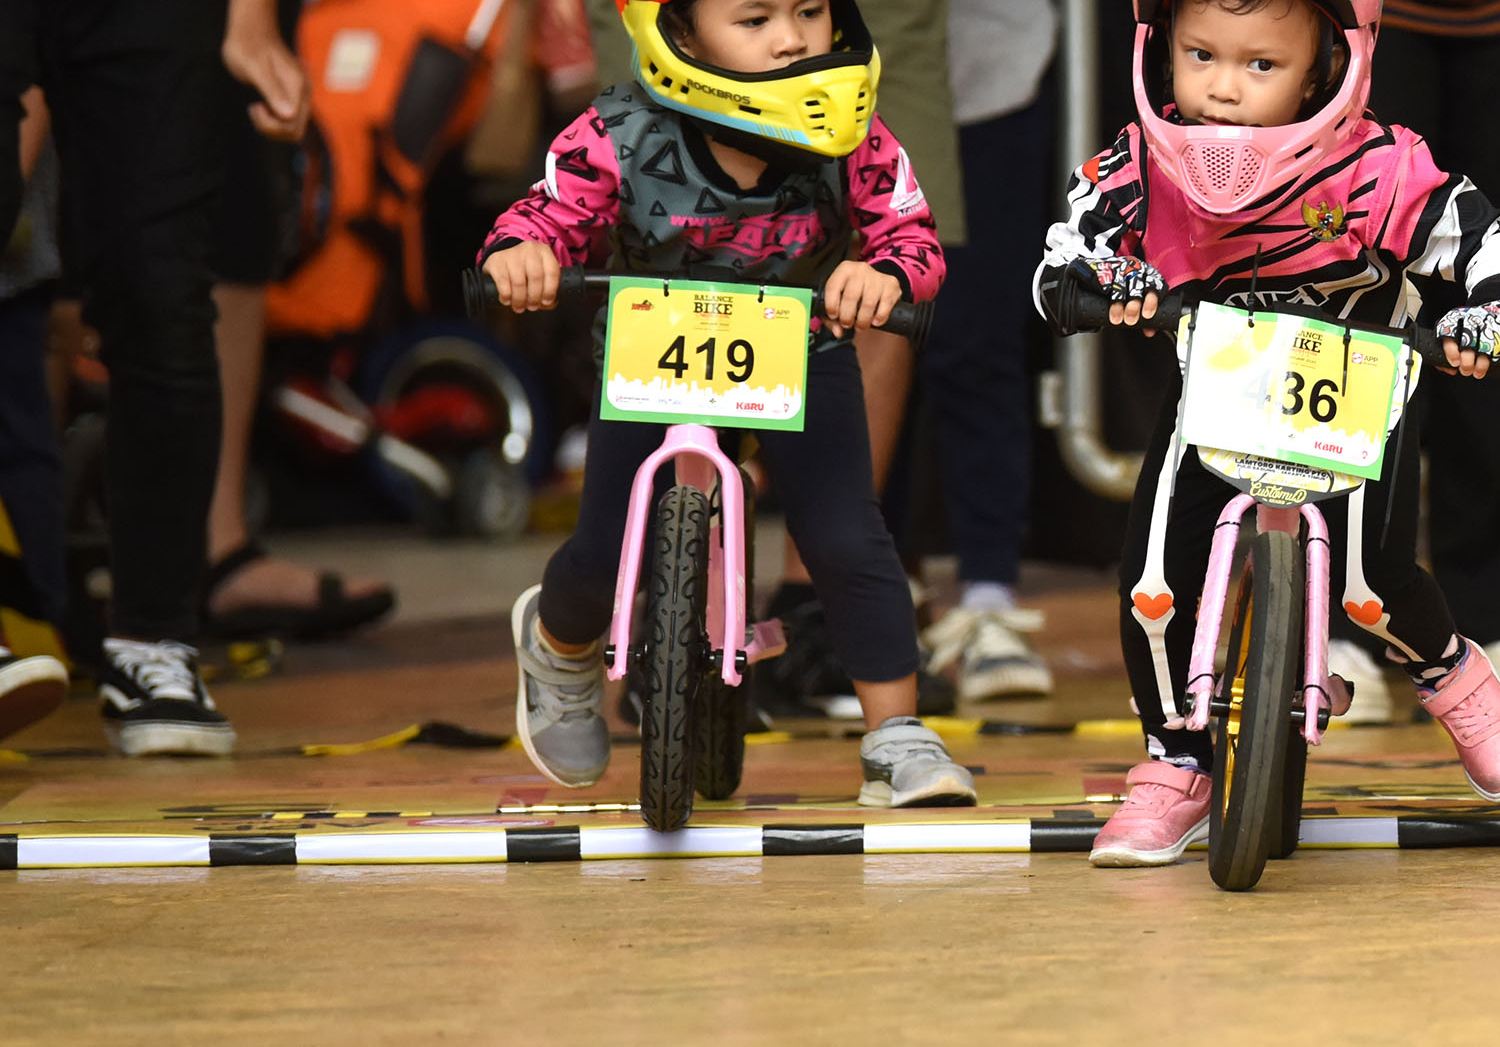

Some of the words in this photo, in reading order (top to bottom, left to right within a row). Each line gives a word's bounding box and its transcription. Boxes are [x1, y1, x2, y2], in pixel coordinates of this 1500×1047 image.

[686, 78, 751, 105] ROCKBROS
[694, 294, 733, 303] BALANCE
[694, 302, 733, 315] BIKE
[1292, 336, 1322, 354] IKE
[657, 335, 755, 383] 419
[1234, 458, 1274, 469] LAMTORO
[1275, 464, 1311, 475] KARTING
